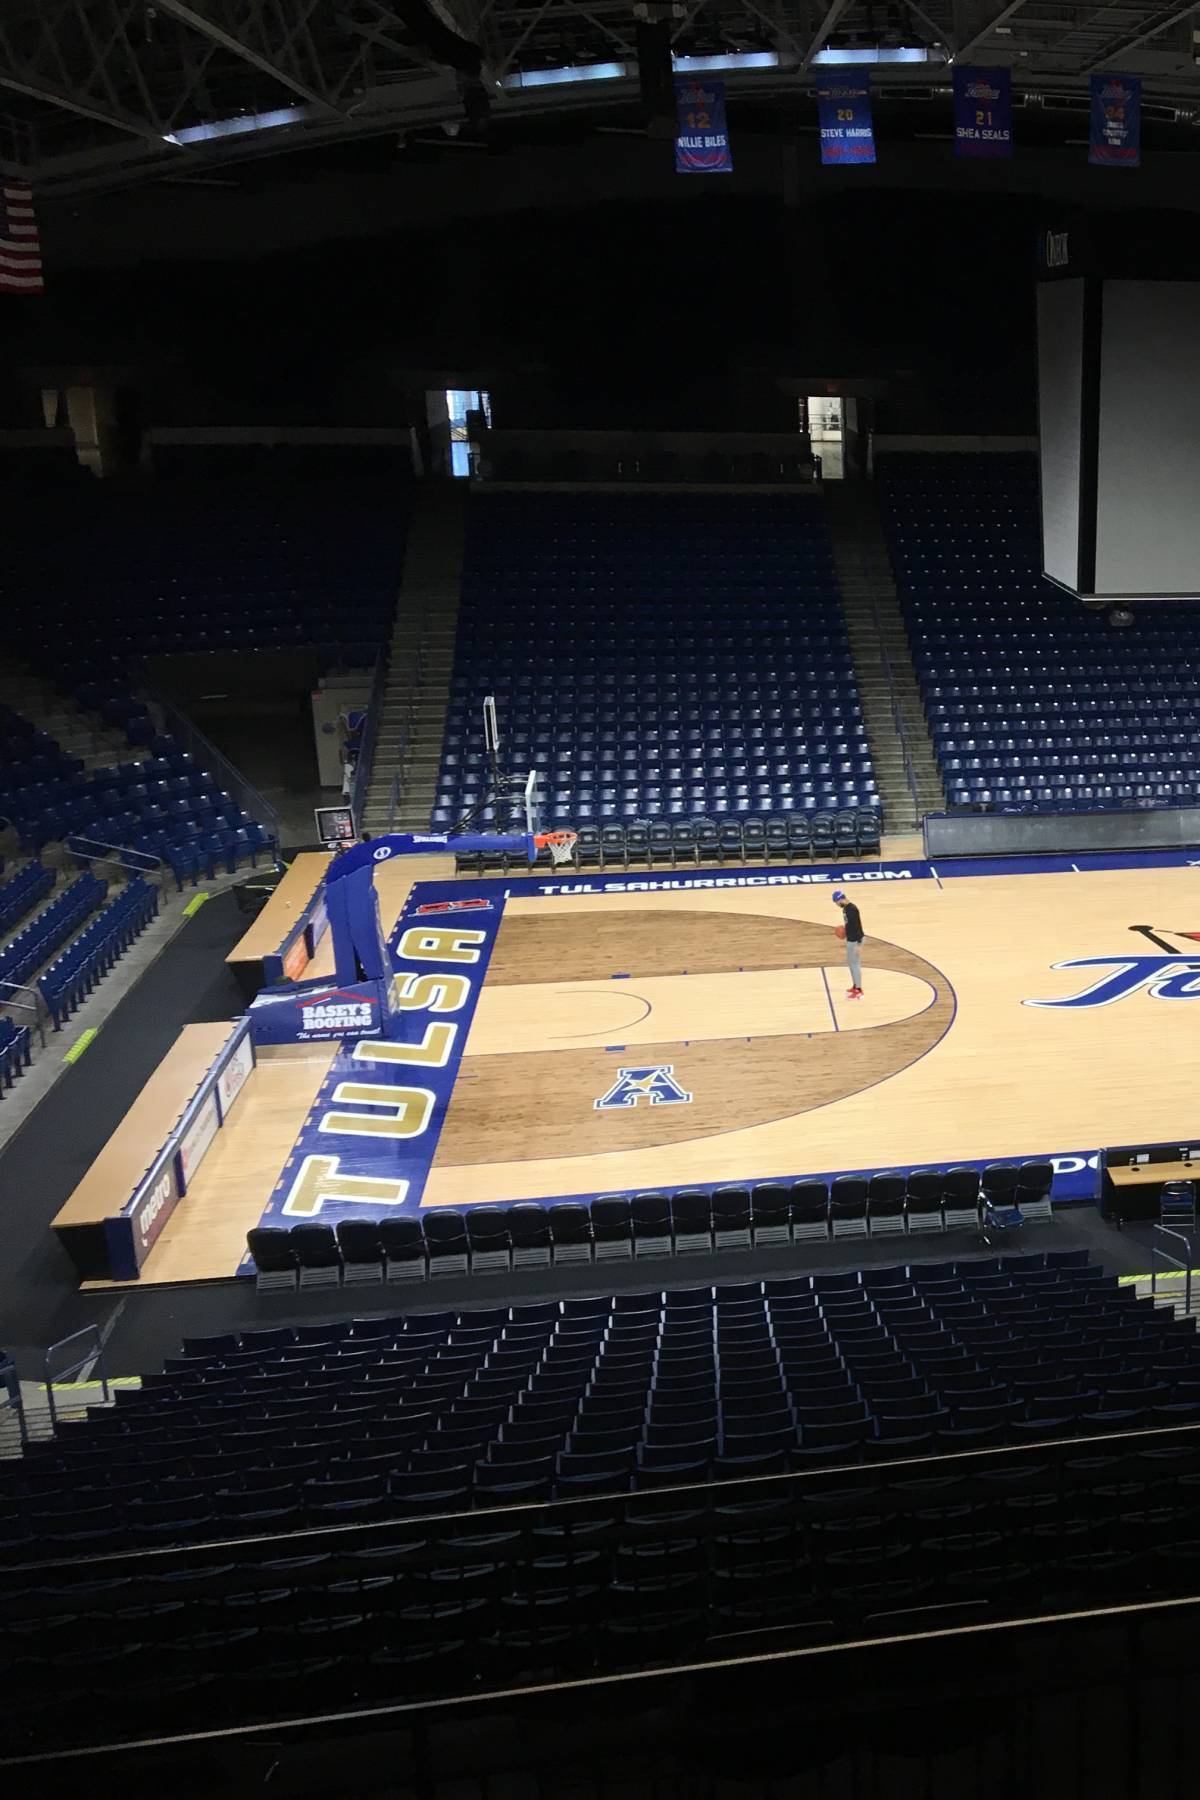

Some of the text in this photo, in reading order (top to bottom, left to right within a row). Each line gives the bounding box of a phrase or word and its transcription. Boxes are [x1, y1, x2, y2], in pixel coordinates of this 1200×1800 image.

[837, 109, 853, 121] 20
[975, 110, 993, 126] 21
[821, 128, 872, 138] STEVE HARRIS
[956, 126, 1010, 141] SHEA SEALS
[705, 135, 726, 147] BILES
[538, 869, 912, 895] TULSAHURRICANE.COM
[302, 1003, 372, 1019] BASEY'S
[303, 1015, 373, 1030] ROOFING
[281, 927, 487, 1217] TULSA
[140, 1174, 171, 1234] metro
